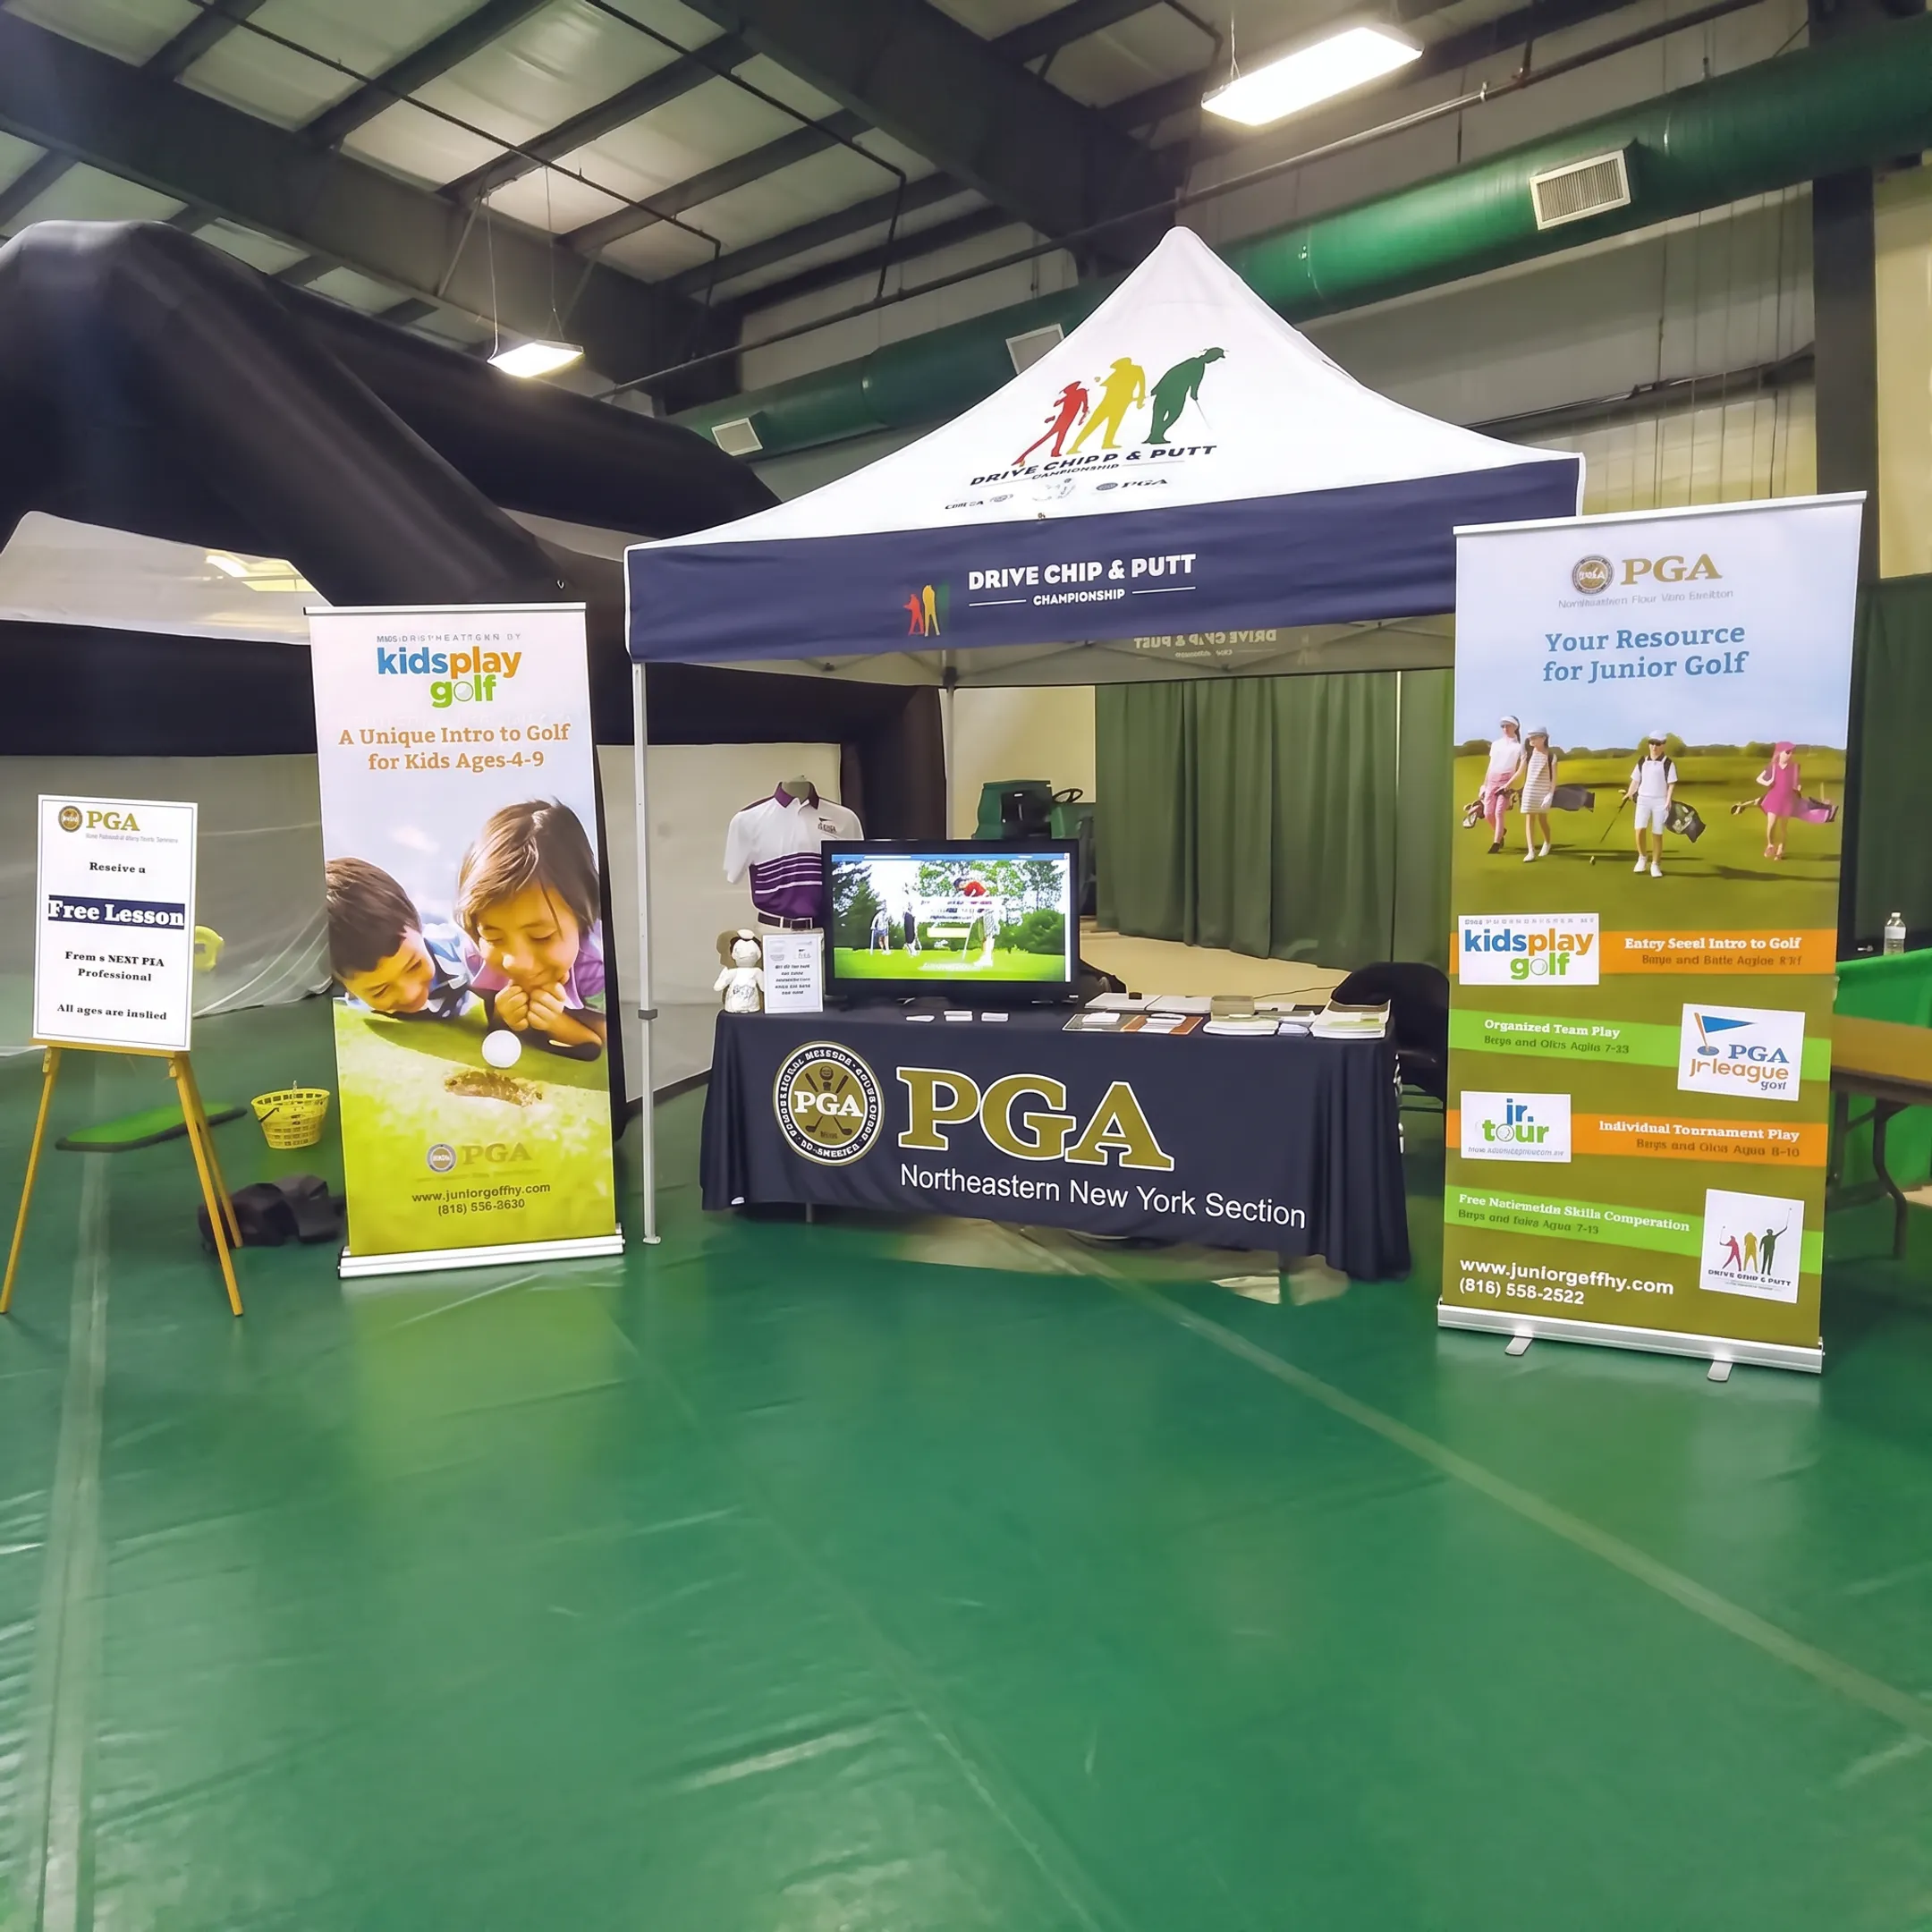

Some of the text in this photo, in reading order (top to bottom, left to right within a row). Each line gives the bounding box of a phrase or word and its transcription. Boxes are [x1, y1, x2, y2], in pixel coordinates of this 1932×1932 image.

[970, 465, 1039, 486] DRIVE
[1125, 450, 1142, 461] &
[1149, 445, 1217, 459] PUTT
[1121, 479, 1168, 488] PGA
[969, 554, 1197, 590] DRIVE CHIP & PUTT
[1621, 553, 1723, 586] PGA
[1033, 589, 1125, 606] CHAMPIONSHIP
[1546, 626, 1745, 652] Your Resource
[377, 646, 522, 680] kidsplay
[1543, 650, 1750, 683] for Junior Golf
[430, 674, 496, 708] golf
[338, 723, 572, 750] A Unique Intro to Golf
[369, 753, 400, 770] for
[404, 752, 450, 769] Kids
[86, 810, 140, 831] PGA
[48, 899, 184, 927] Free Lesson
[1464, 928, 1594, 957] kidsplay
[1708, 937, 1747, 949] Intro
[1750, 938, 1767, 949] to
[1769, 936, 1801, 949] Golf
[107, 954, 139, 965] NEXT
[1510, 952, 1570, 980] golf
[1676, 955, 1699, 965] and
[78, 968, 152, 982] Professional
[57, 1004, 73, 1013] All
[76, 1006, 103, 1016] ages
[106, 1009, 123, 1018] are
[1484, 1019, 1621, 1039] Organized Team Play
[1515, 1038, 1537, 1047] and
[1728, 1044, 1790, 1063] PGA
[794, 1090, 864, 1118] PGA
[1506, 1098, 1534, 1125] jr.
[896, 1066, 1174, 1171] PGA
[1482, 1120, 1549, 1143] tour
[1767, 1129, 1800, 1142] Play
[462, 1141, 533, 1165] PGA
[1671, 1141, 1695, 1151] and
[901, 1163, 1306, 1230] Northeastern New York Section
[1459, 1194, 1486, 1206] Free
[1604, 1211, 1690, 1232] Comperation
[1489, 1213, 1509, 1224] and
